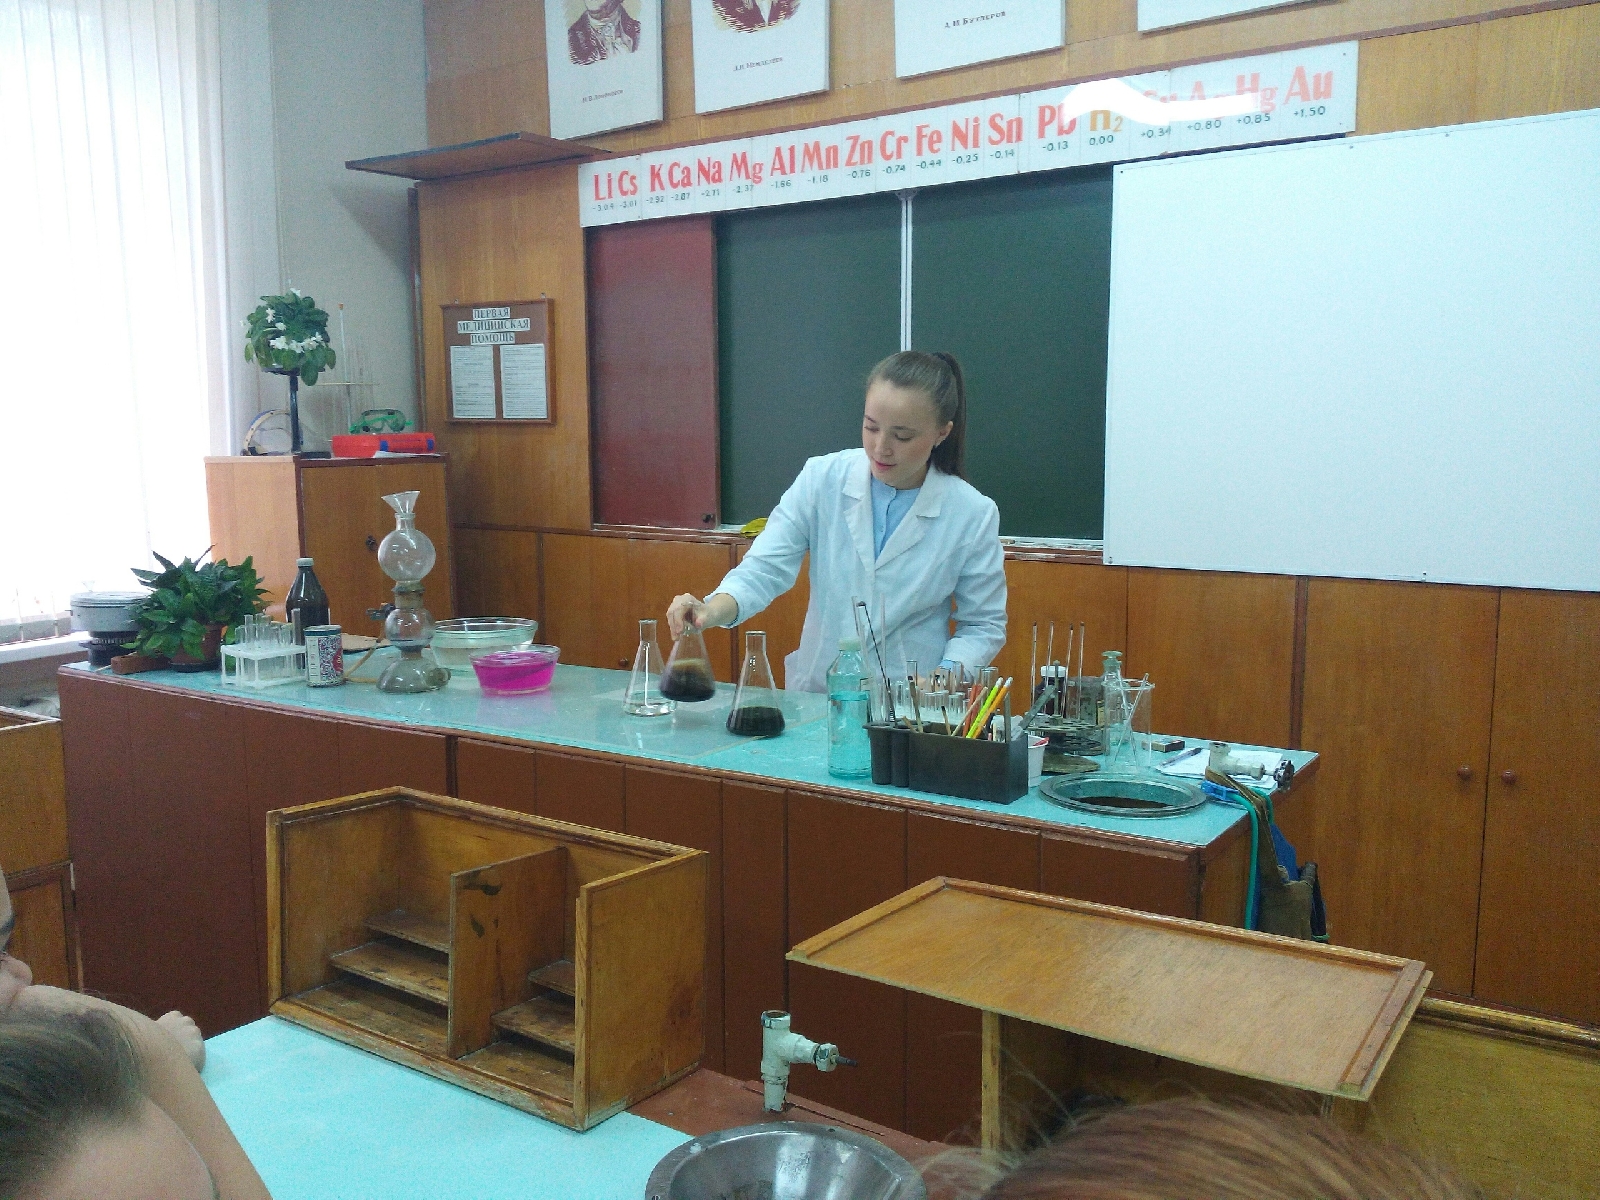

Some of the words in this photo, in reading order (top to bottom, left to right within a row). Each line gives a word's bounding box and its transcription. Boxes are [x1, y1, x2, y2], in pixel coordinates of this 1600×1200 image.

[594, 172, 613, 201] Li
[618, 170, 638, 196] Cs
[650, 164, 665, 192] K
[668, 161, 693, 189] Ca
[697, 157, 723, 186] Na
[730, 151, 764, 184] Mg
[770, 144, 796, 176] Al
[800, 140, 838, 173] Mn
[845, 135, 874, 167] Zn
[880, 130, 909, 161] Cr
[916, 124, 943, 156] Fe
[951, 116, 980, 151] Ni
[988, 112, 1023, 146] Sn
[1283, 65, 1333, 105] Au
[952, 153, 979, 164] -0.25
[1042, 140, 1069, 151] -0.13
[1089, 134, 1114, 146] 0.00
[474, 307, 509, 318] ПЕРВАЯ
[458, 319, 529, 331] МЕДИЦИНСКАЯ
[471, 332, 514, 343] ПОМОЩЬ
